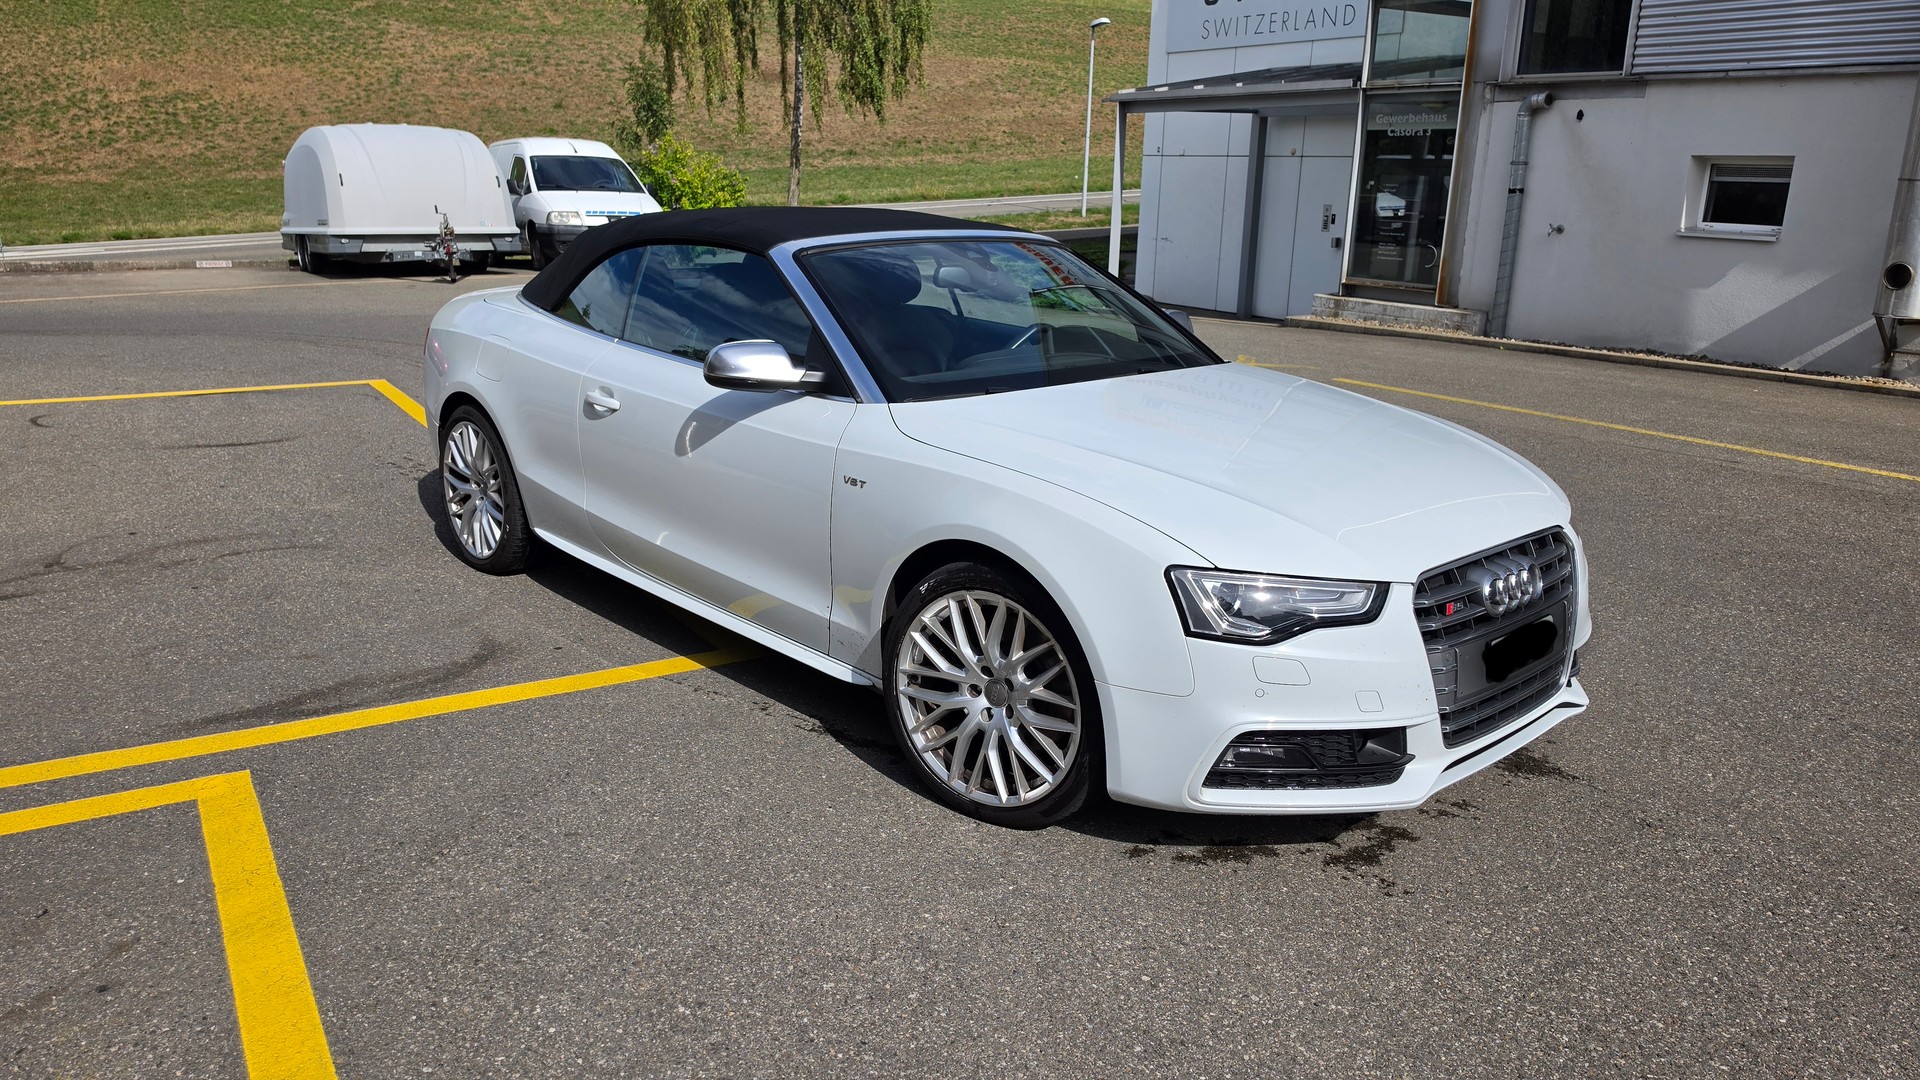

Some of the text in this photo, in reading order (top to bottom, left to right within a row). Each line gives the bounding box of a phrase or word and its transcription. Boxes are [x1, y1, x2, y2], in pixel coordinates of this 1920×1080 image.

[1201, 4, 1356, 39] SWITZERLAND
[1375, 113, 1448, 124] Gewerbehaus
[1387, 127, 1432, 136] Casora 3
